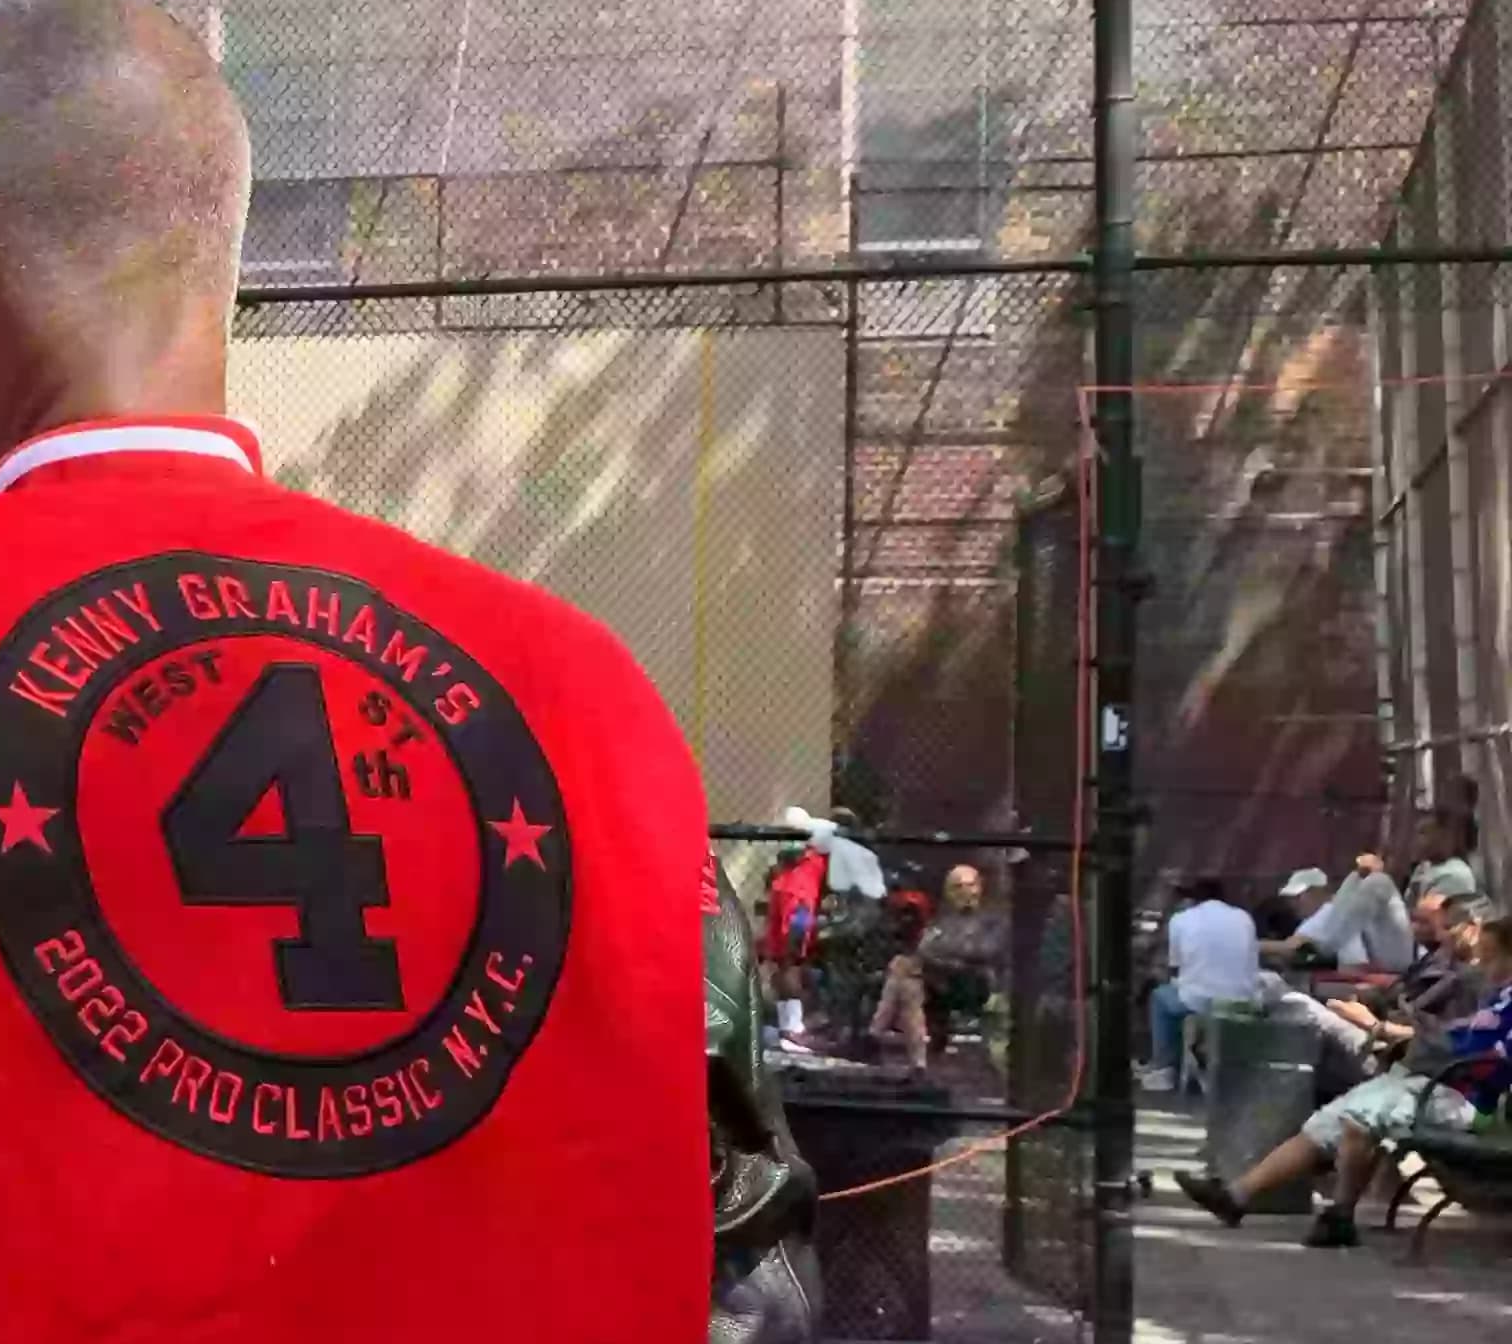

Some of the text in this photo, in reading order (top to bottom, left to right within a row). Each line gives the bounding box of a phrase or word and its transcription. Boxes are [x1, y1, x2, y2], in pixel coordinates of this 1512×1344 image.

[8, 572, 481, 726] KENNY GRAHAM'S
[100, 649, 428, 1012] WEST 4 ST
[354, 749, 412, 801] th
[33, 929, 150, 1064] 2022
[138, 1037, 245, 1125] PRO
[252, 1057, 445, 1144] CLASSIC
